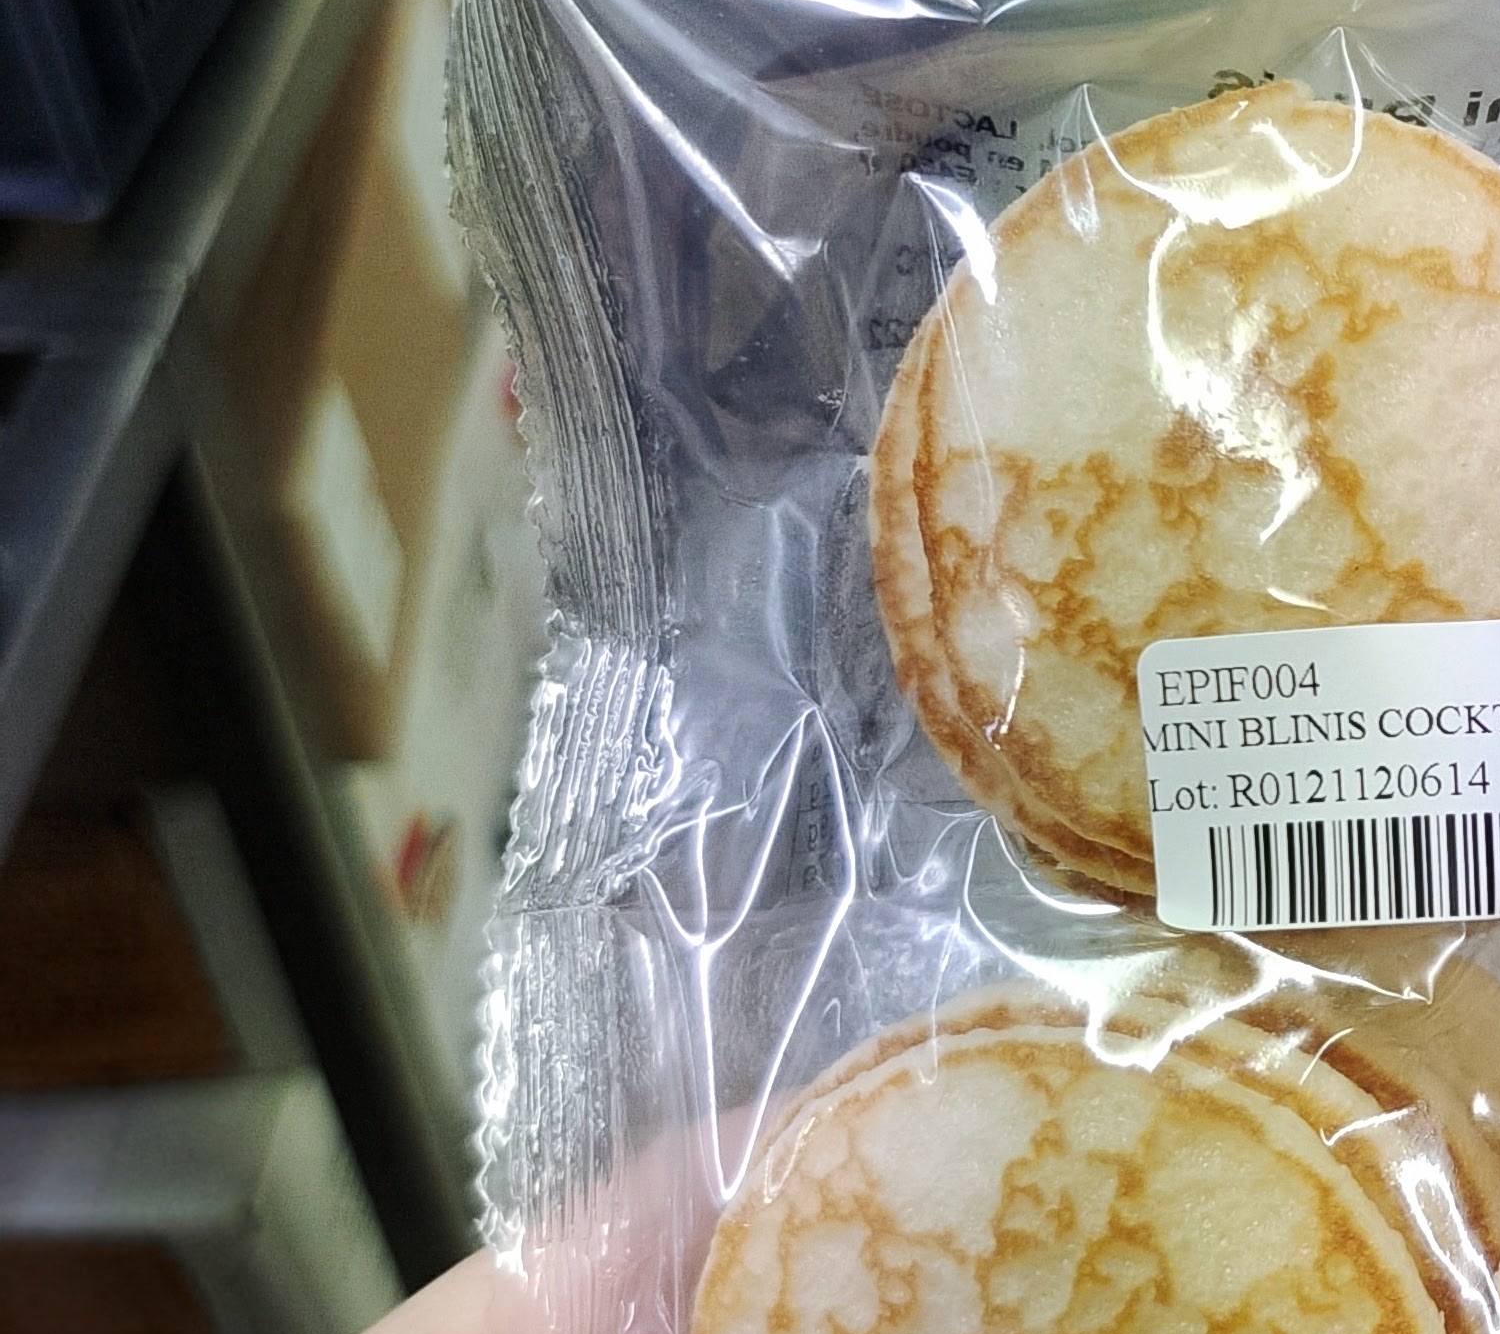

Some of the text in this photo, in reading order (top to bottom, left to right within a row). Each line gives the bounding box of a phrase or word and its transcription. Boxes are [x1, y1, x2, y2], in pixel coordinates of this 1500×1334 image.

[1156, 662, 1320, 707] EPIF004
[1143, 721, 1229, 754] MINI
[1240, 710, 1367, 748] BLINIS
[1148, 777, 1219, 813] Lot:
[1227, 760, 1491, 809] R0121120614
